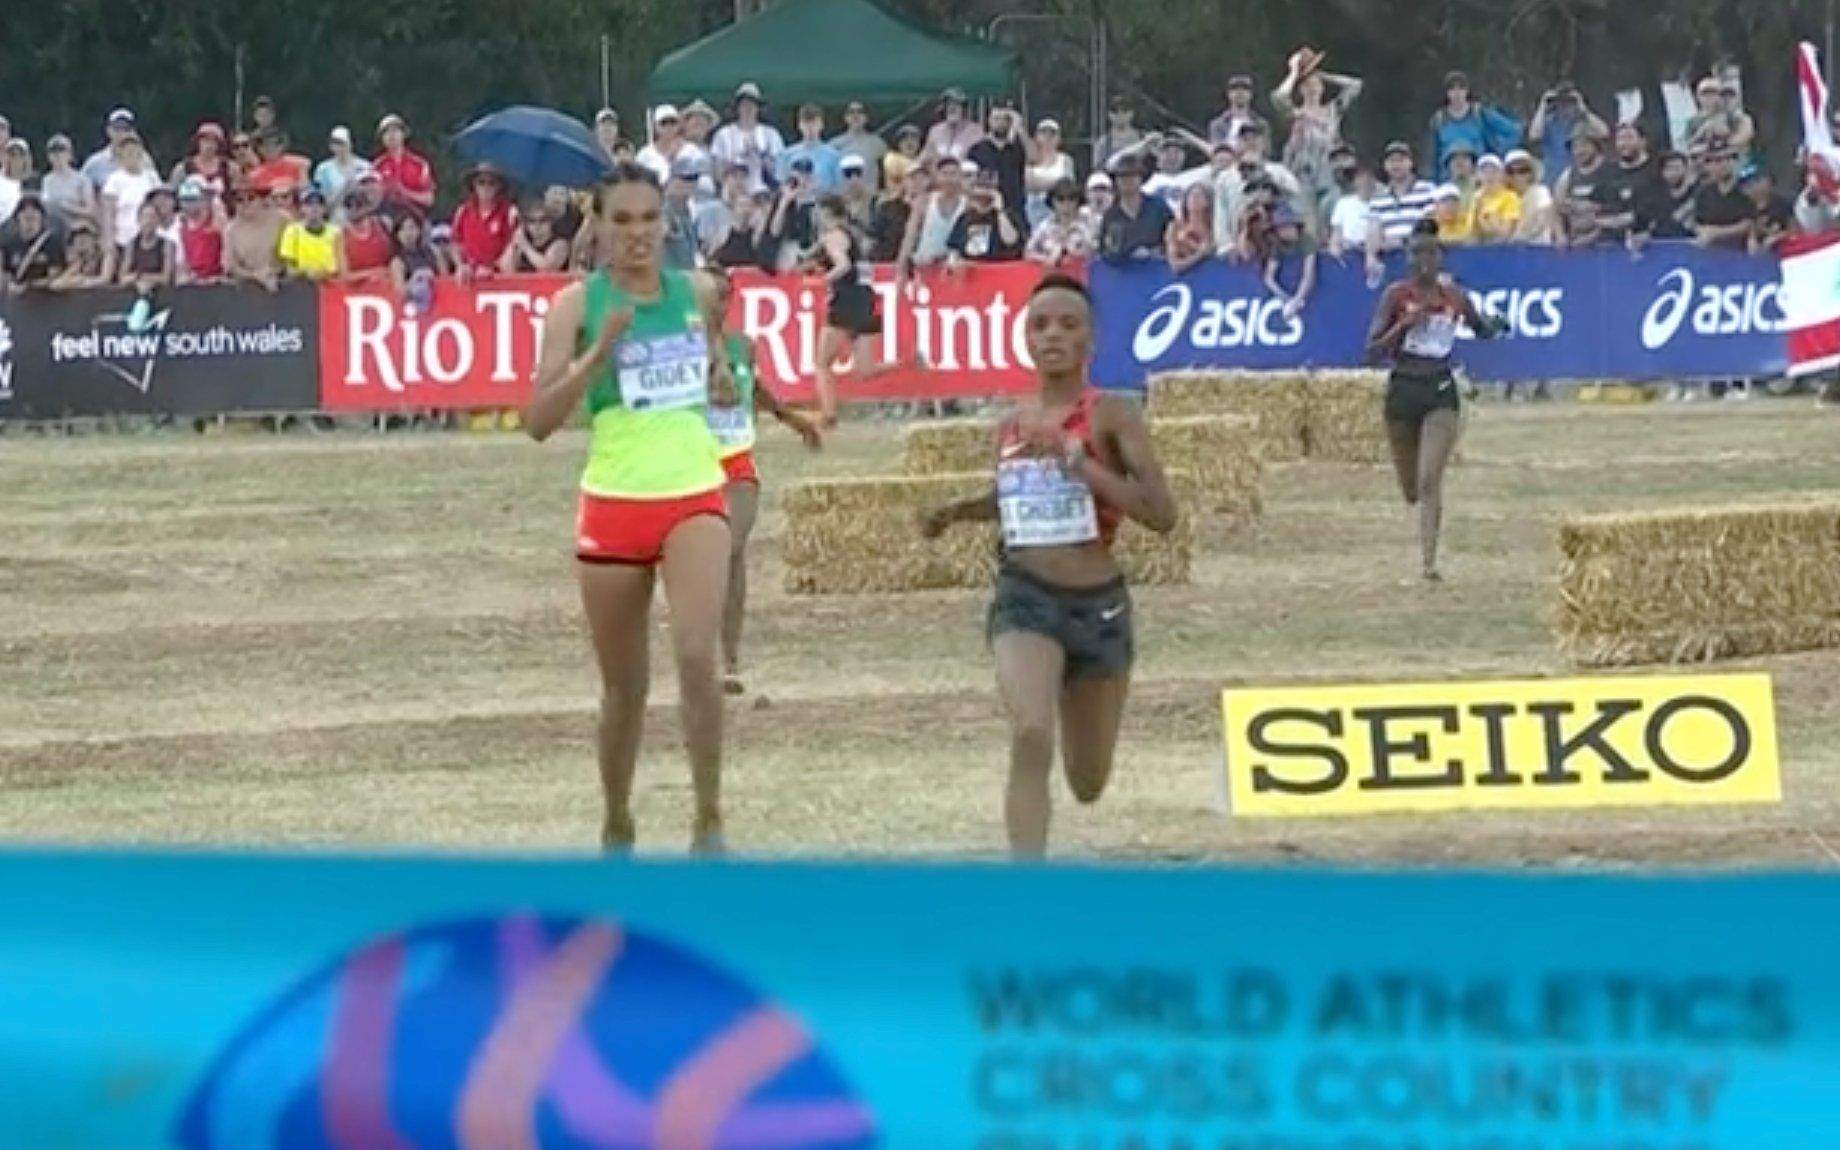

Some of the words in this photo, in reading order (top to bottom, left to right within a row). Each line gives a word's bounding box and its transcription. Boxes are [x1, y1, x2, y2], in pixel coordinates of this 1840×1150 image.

[51, 329, 99, 361] feel
[103, 331, 160, 357] new
[166, 325, 235, 355] south
[239, 322, 303, 353] wales
[343, 294, 474, 392] Rio
[740, 286, 855, 384] Ri
[1190, 296, 1303, 349] asics
[1693, 281, 1789, 334] asics
[1246, 694, 1752, 796] SEIKO
[967, 965, 1292, 1036] WORLD
[1310, 970, 1796, 1050] ATHLETICS
[972, 1050, 1273, 1121] CROSS
[1295, 1052, 1730, 1126] COUNTRY
